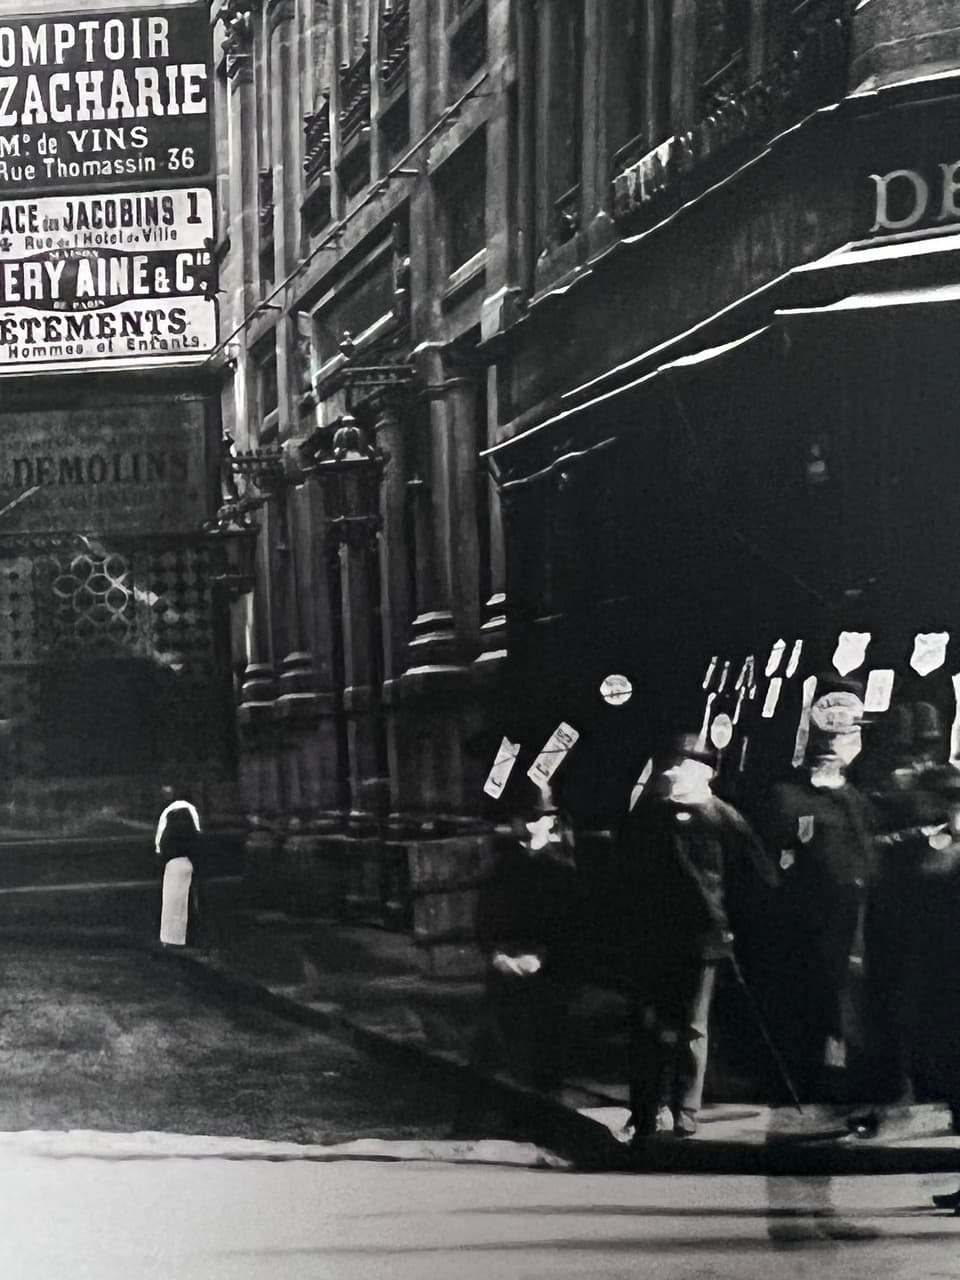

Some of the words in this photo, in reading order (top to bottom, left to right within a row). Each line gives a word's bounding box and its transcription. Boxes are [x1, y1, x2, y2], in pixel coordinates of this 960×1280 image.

[38, 132, 58, 155] de
[67, 126, 149, 153] VINS
[43, 154, 156, 179] Thomassin
[167, 147, 195, 170] 36
[63, 195, 175, 232] JACOBINS
[186, 192, 203, 225] 1
[24, 235, 53, 251] Rue
[142, 226, 178, 243] Ville
[76, 255, 149, 299] AINE
[154, 266, 171, 293] &
[8, 344, 84, 360] Hommes
